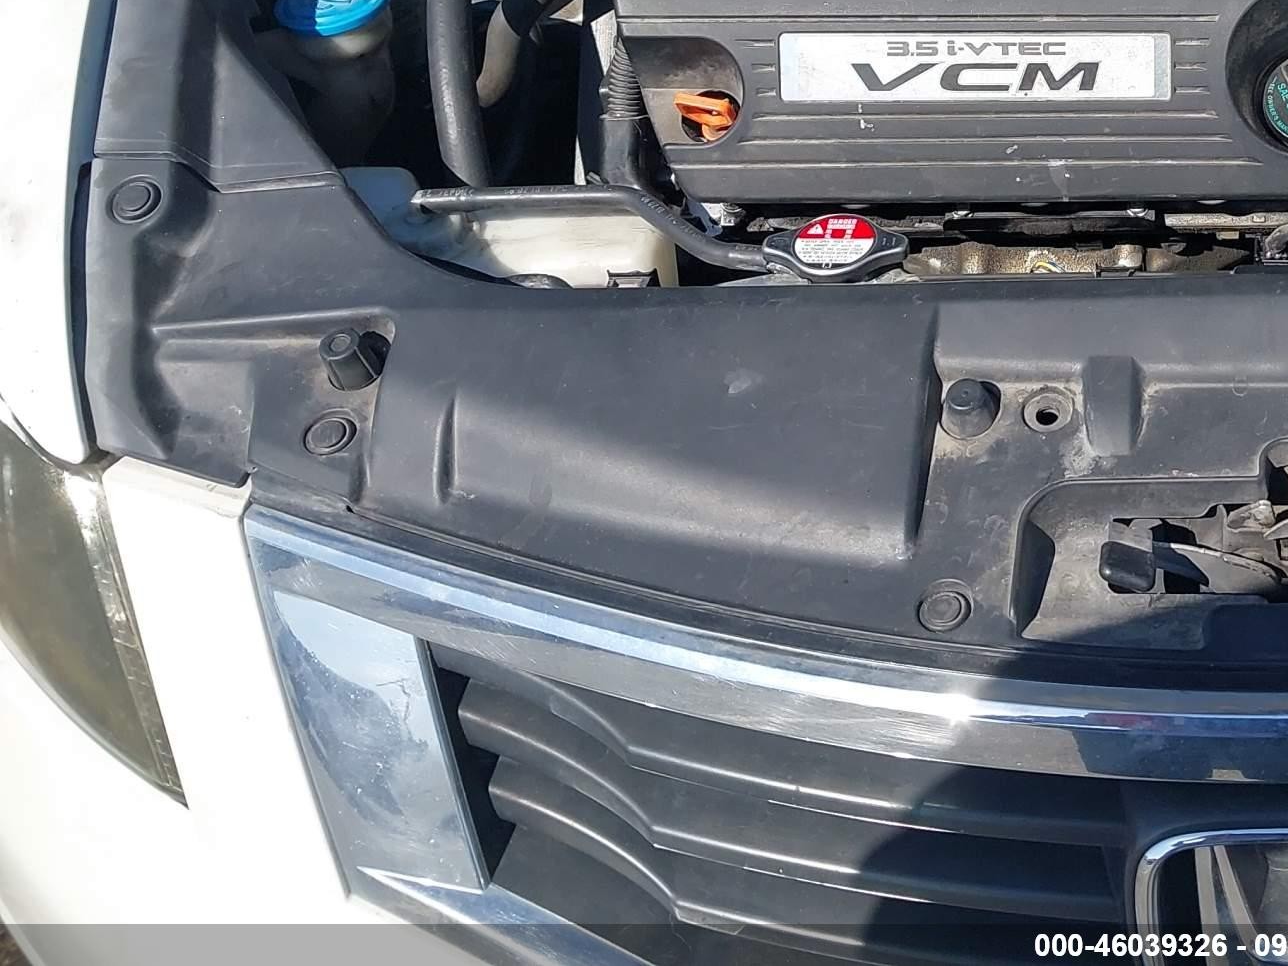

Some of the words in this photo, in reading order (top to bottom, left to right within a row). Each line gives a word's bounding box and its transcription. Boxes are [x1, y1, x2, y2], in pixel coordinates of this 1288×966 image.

[887, 41, 938, 56] 3.5
[947, 41, 1066, 56] i-VTEC
[851, 61, 1102, 92] VCM
